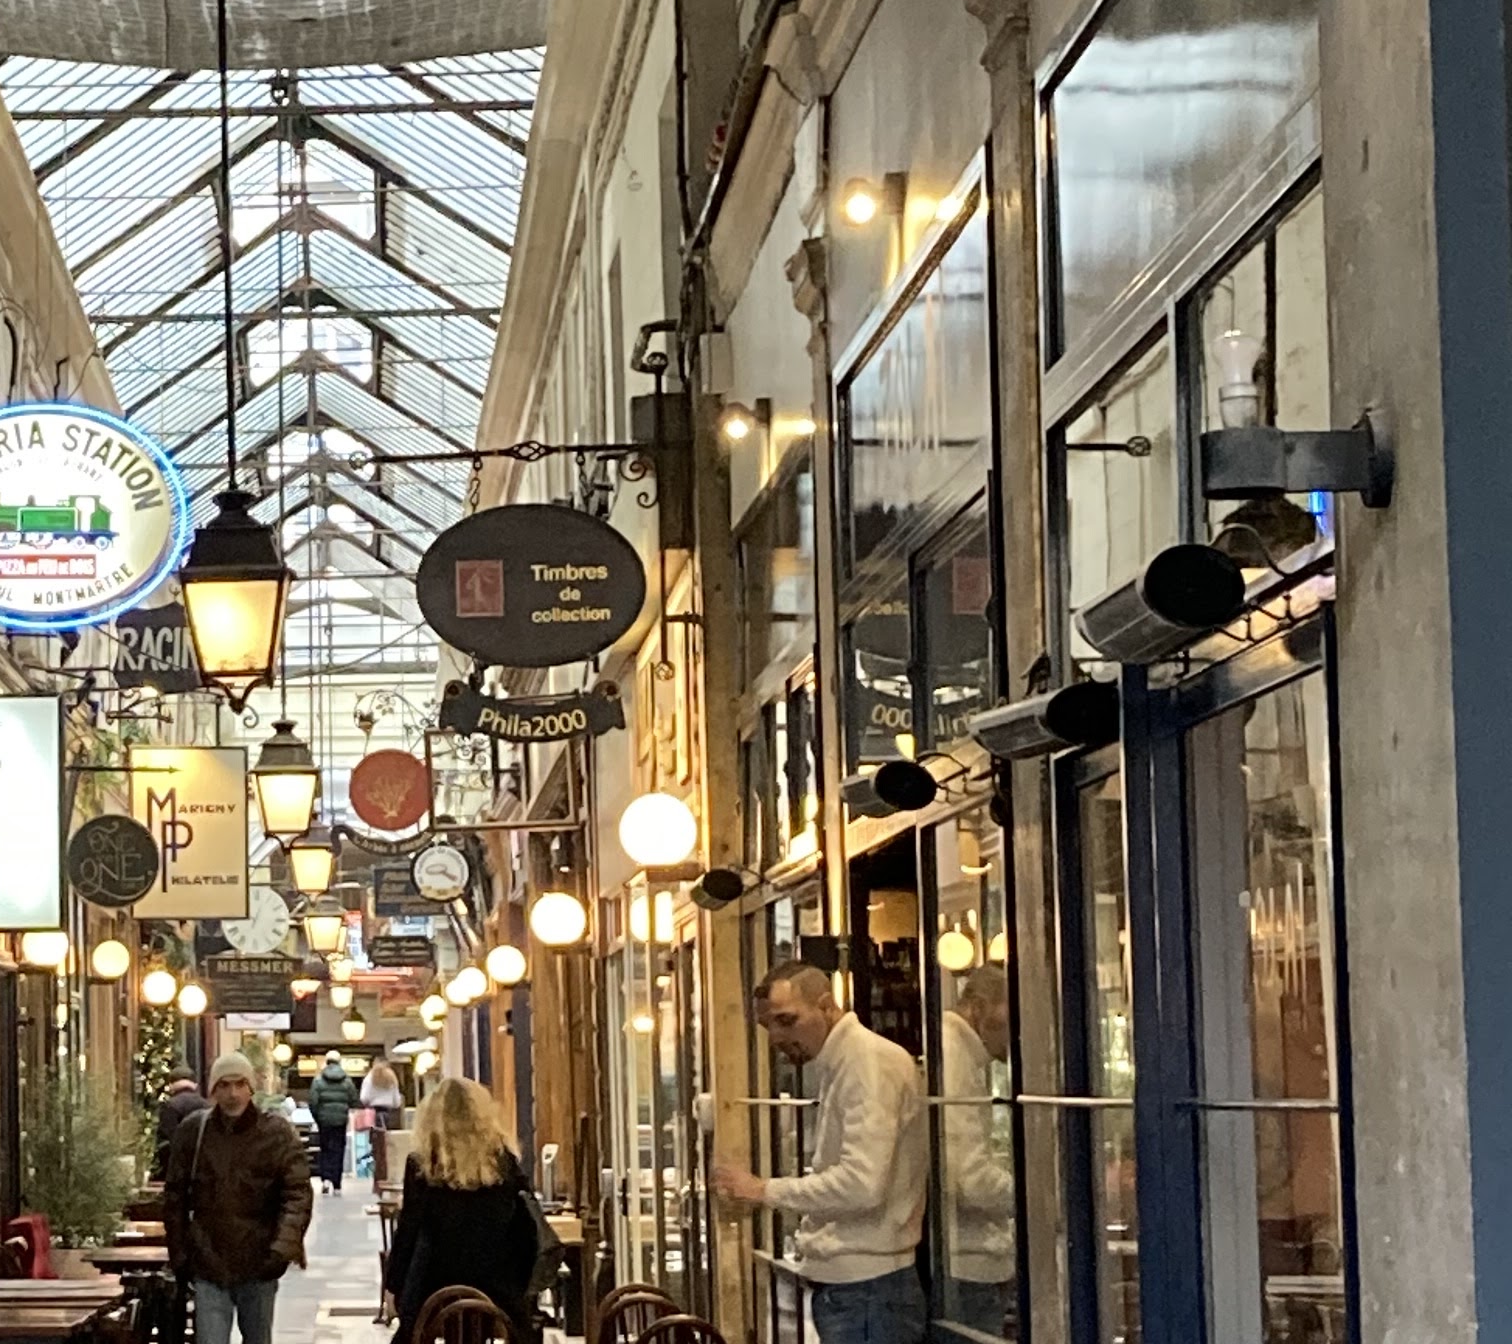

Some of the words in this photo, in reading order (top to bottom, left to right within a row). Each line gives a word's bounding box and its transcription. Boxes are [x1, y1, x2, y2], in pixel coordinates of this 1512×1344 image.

[61, 423, 164, 511] STATION
[531, 563, 609, 582] Timbres
[34, 562, 134, 605] MONTMARTRE
[559, 586, 582, 602] de
[531, 607, 612, 623] collection
[477, 707, 588, 737] Phila2000
[216, 959, 294, 973] MESSMER
